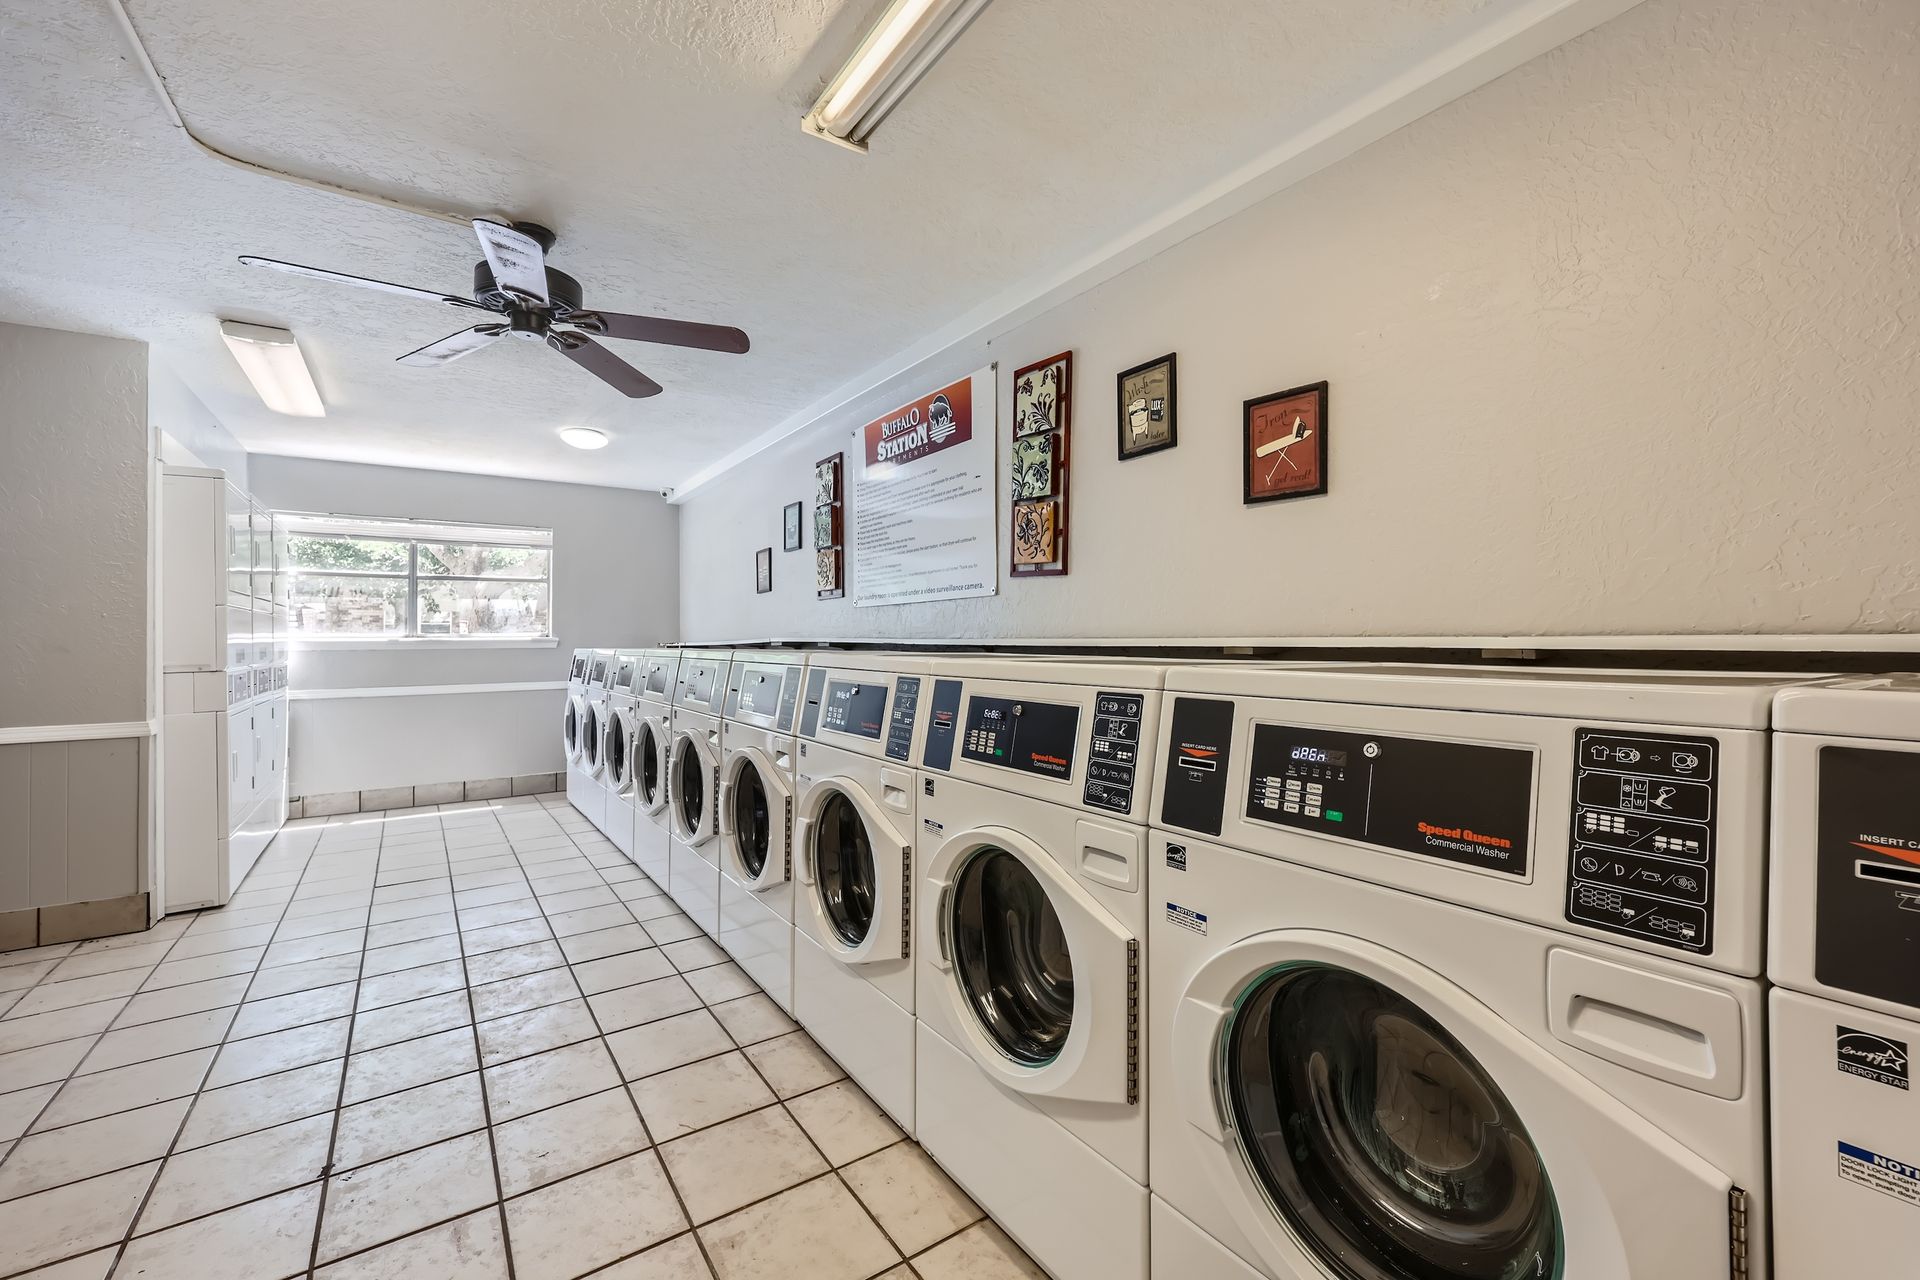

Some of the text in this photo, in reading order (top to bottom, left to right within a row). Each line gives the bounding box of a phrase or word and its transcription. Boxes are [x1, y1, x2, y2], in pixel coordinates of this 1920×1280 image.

[881, 408, 919, 439] BUFFALO
[877, 422, 928, 461] STATION
[924, 587, 936, 595] video
[936, 584, 963, 593] surveillance
[964, 582, 984, 591] camera.
[1032, 752, 1048, 762] Speed
[1417, 821, 1511, 848] Speed Queen
[1425, 835, 1510, 860] Commercial Washer
[1860, 834, 1905, 846] INSERT
[1176, 906, 1197, 919] NOTICE
[1839, 1062, 1908, 1089] ENERGY STAR
[1841, 1156, 1918, 1187] DOOR LOCK LIGHT
[1841, 1162, 1865, 1175] before
[1867, 1173, 1909, 1192] attempting
[1841, 1168, 1917, 1200] To open, push door
